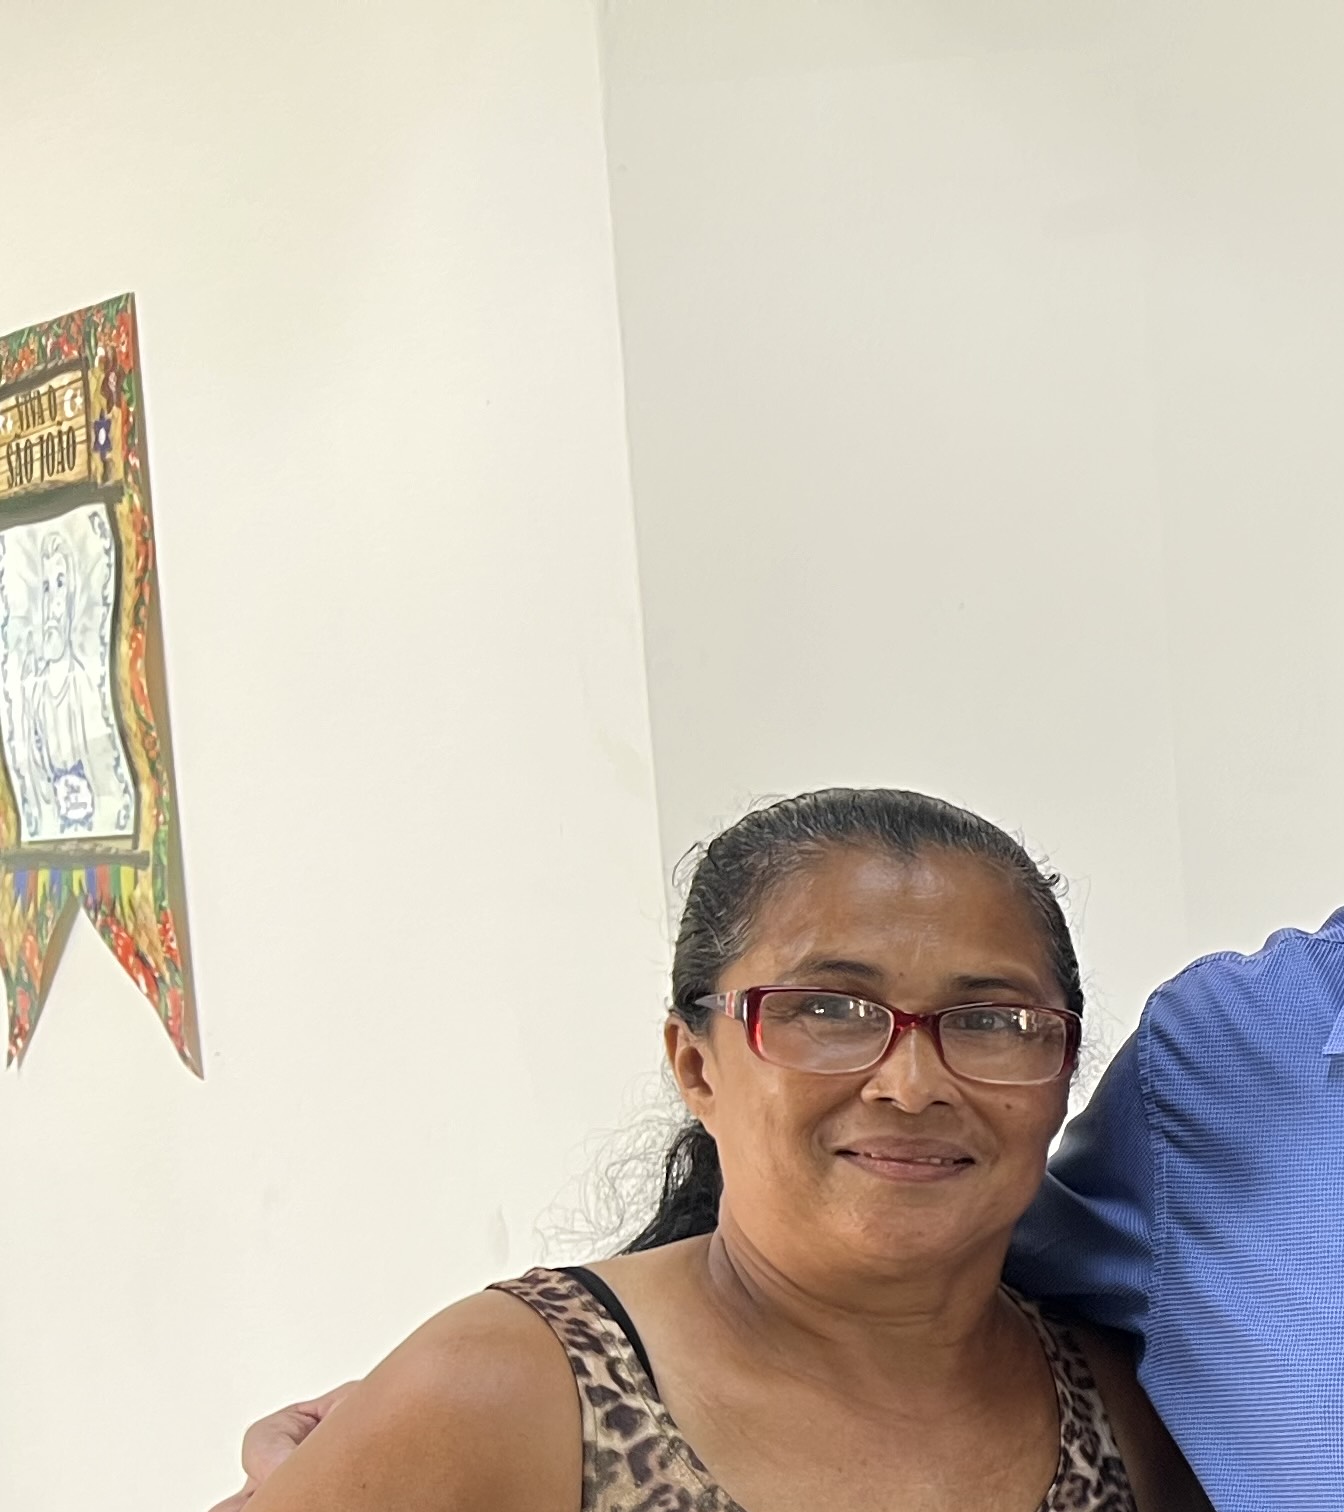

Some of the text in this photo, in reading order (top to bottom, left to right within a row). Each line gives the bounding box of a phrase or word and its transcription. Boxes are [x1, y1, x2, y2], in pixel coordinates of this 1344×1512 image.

[14, 389, 45, 432] VIVA
[6, 421, 77, 489] SÃO JOÃO
